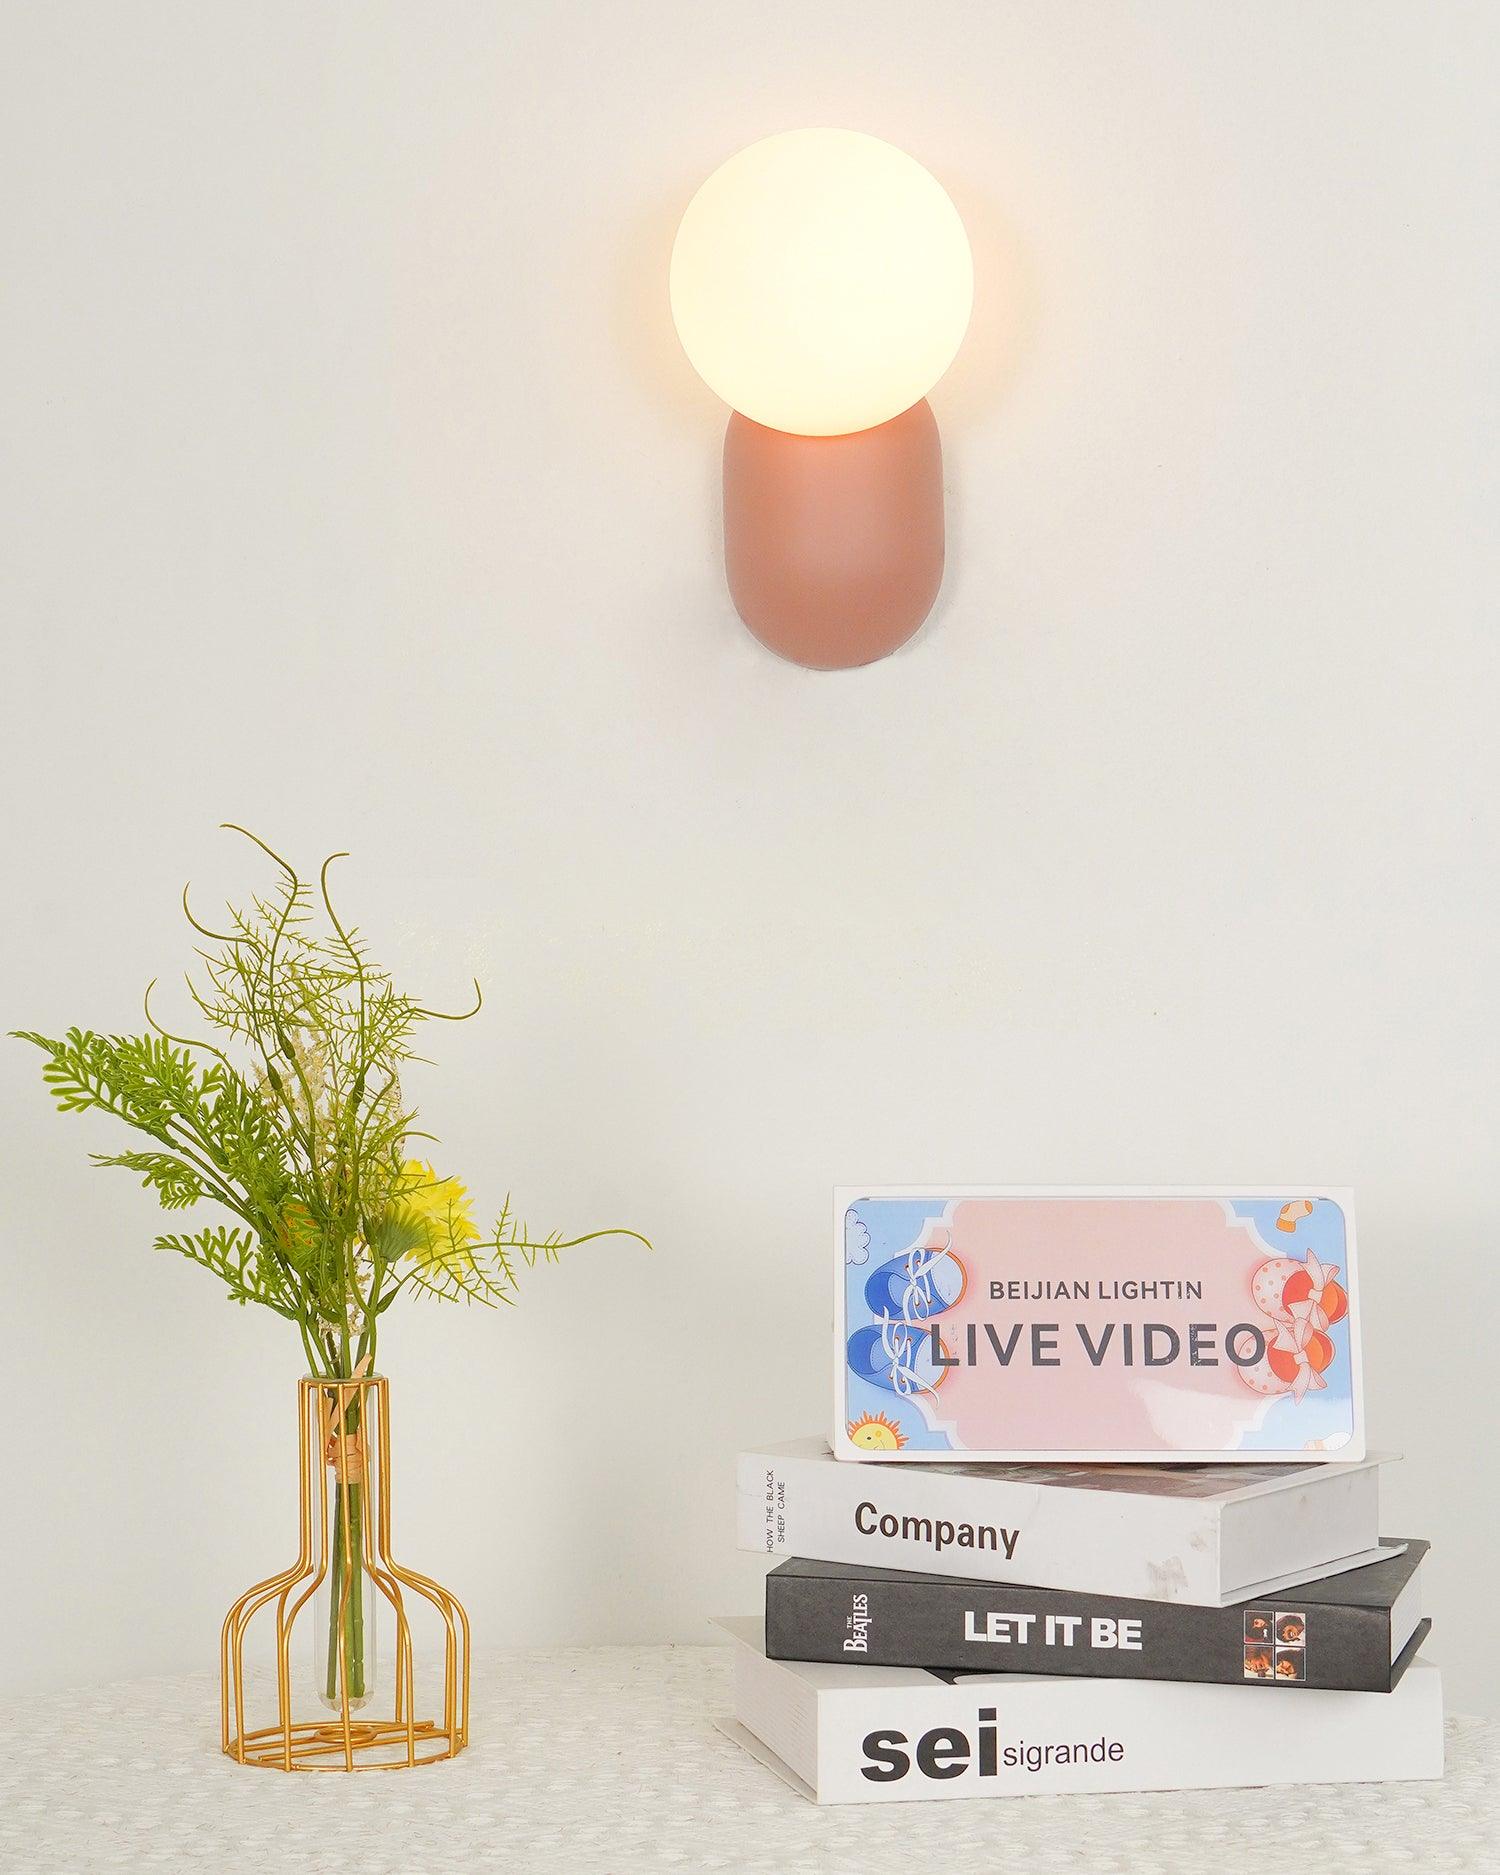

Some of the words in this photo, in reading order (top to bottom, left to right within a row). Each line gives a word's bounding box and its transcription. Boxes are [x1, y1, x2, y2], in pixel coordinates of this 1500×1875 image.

[990, 1280, 1090, 1300] BEIJIAN
[1098, 1280, 1202, 1300] LIGHTIN
[930, 1323, 1061, 1367] LIVE
[1075, 1323, 1266, 1367] VIDEO
[765, 1469, 774, 1501] BLACK
[777, 1481, 786, 1510] CAME
[765, 1505, 774, 1524] THE
[777, 1514, 786, 1544] SHEEP
[855, 1501, 1020, 1560] Company
[765, 1528, 774, 1553] HOW
[843, 1593, 873, 1653] BEATLES
[964, 1610, 1037, 1645] LET
[1044, 1613, 1084, 1648] IT
[1090, 1616, 1144, 1651] BE
[860, 1707, 998, 1782] sei
[1003, 1736, 1125, 1773] sigrande
